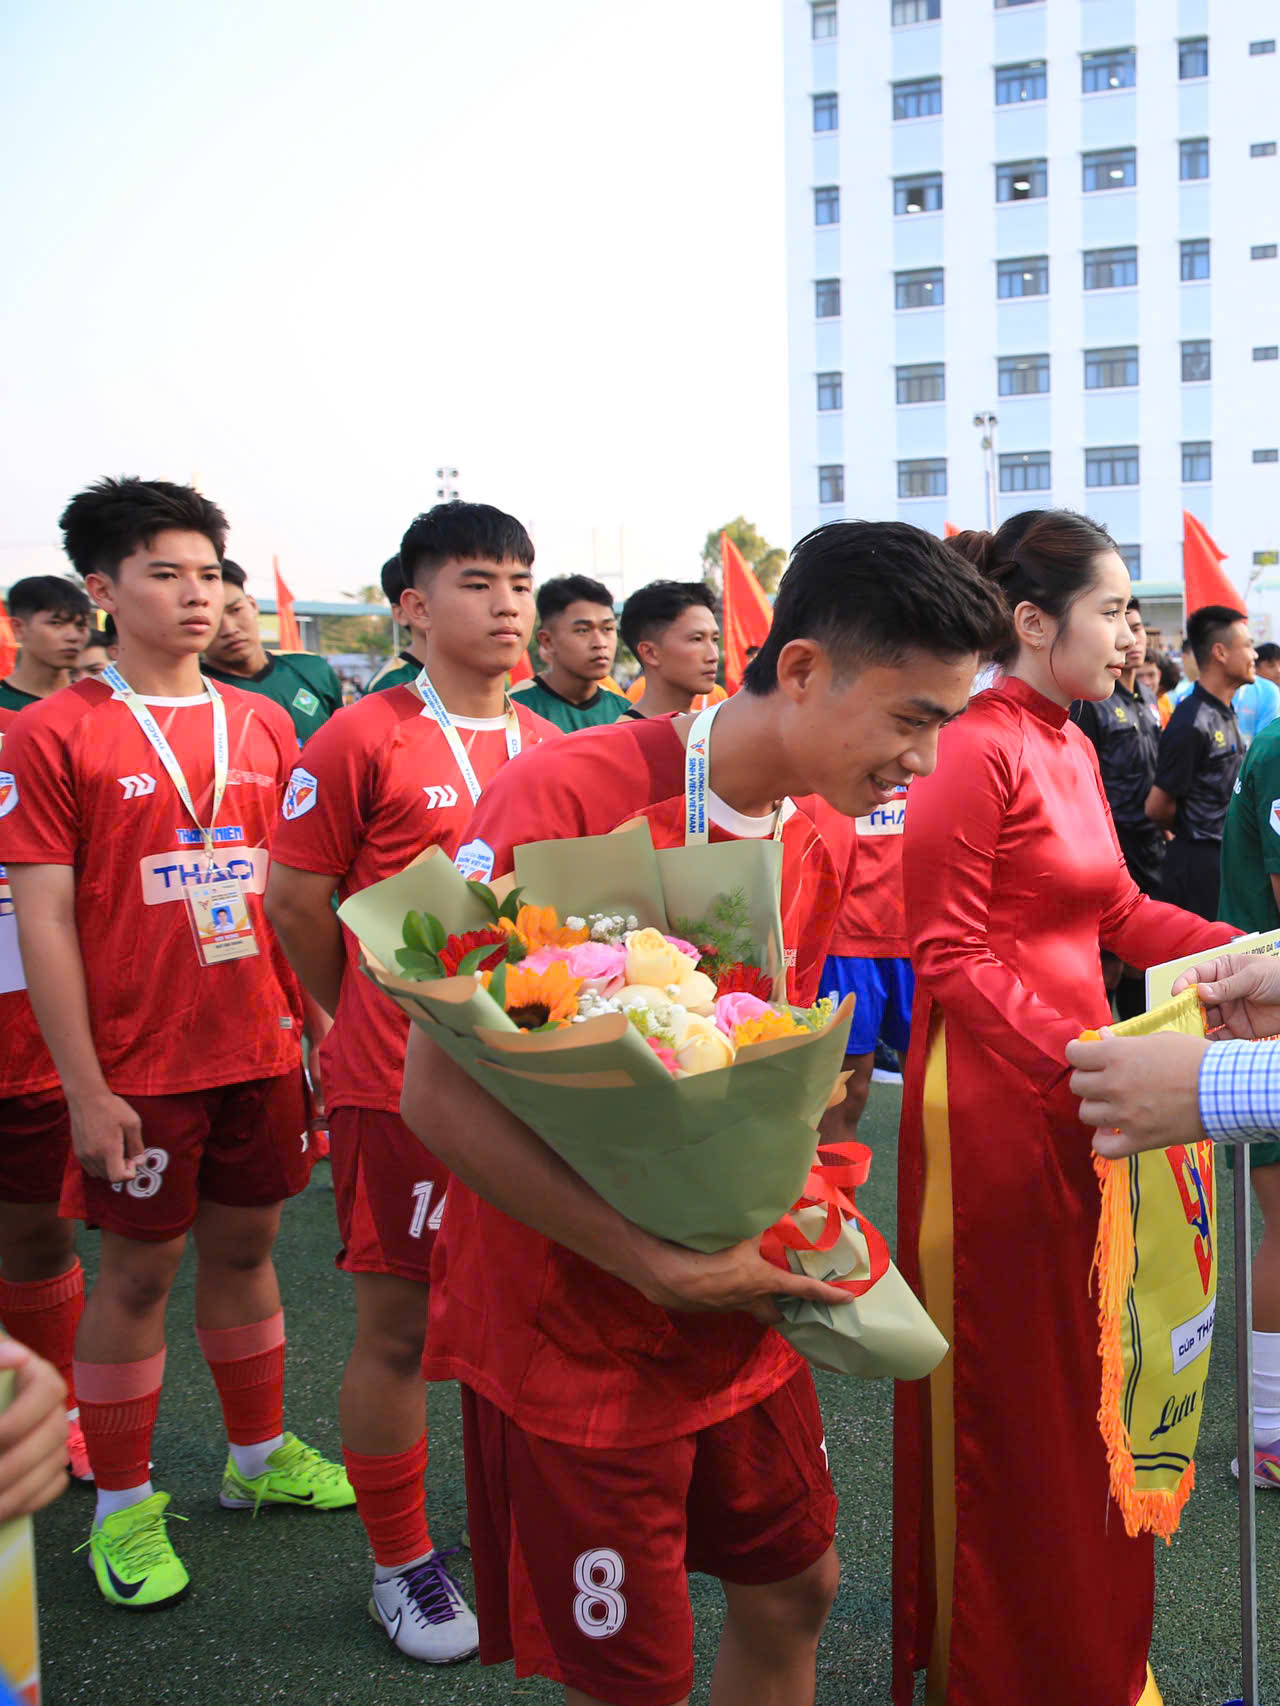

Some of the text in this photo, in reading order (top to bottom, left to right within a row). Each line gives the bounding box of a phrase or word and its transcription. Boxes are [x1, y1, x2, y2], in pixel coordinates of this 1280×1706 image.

[689, 757, 697, 776] SINH
[689, 814, 697, 833] NAM
[870, 809, 905, 825] THA
[153, 860, 254, 888] THAC
[1179, 1306, 1216, 1356] CÚP THA
[573, 1547, 627, 1640] 8
